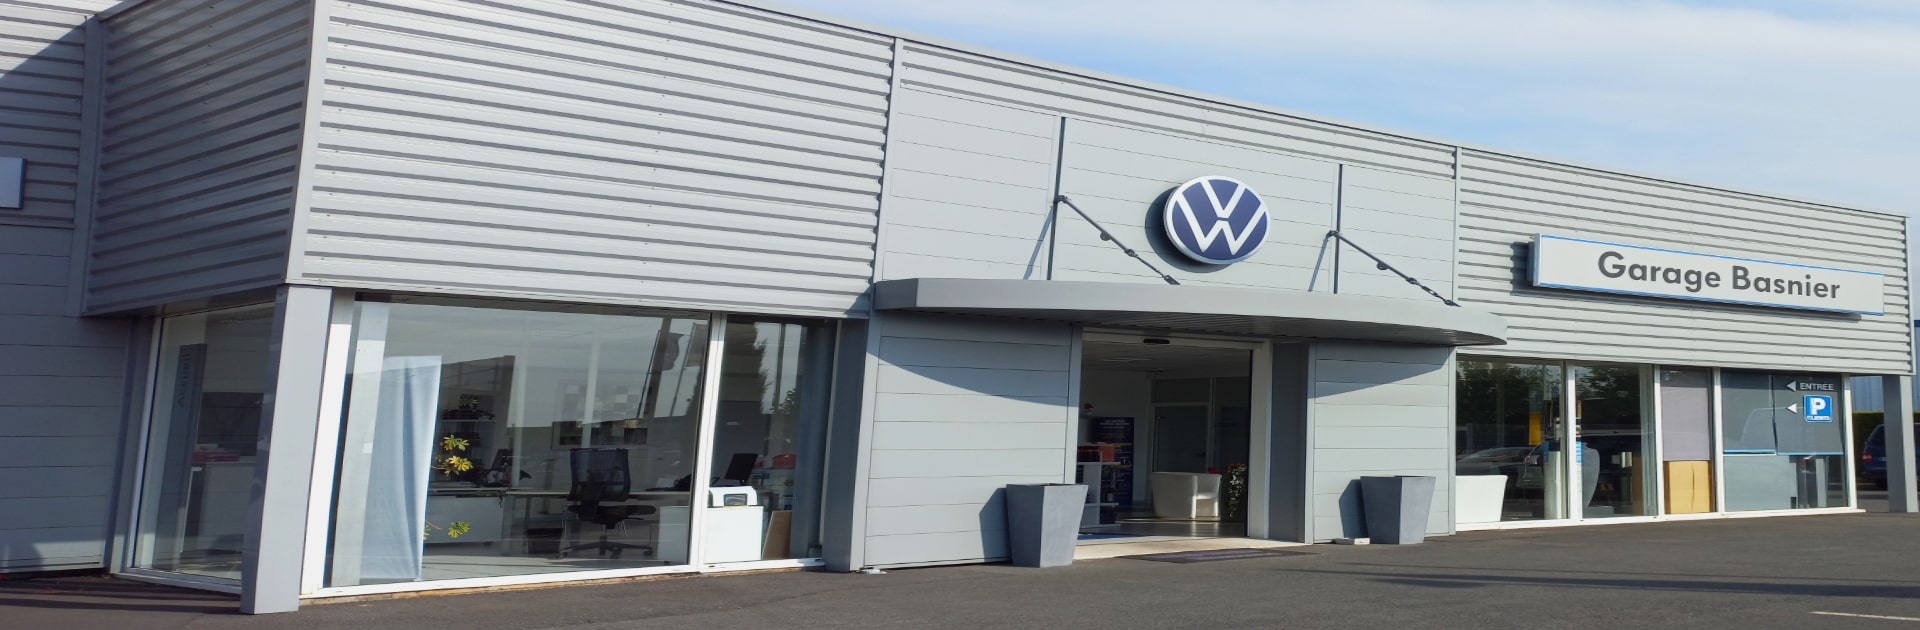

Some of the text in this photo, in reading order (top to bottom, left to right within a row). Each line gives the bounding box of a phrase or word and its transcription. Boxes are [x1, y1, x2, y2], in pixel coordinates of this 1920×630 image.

[1171, 177, 1269, 259] VW
[1597, 250, 1841, 299] Garage Basnier
[1809, 397, 1827, 415] P
